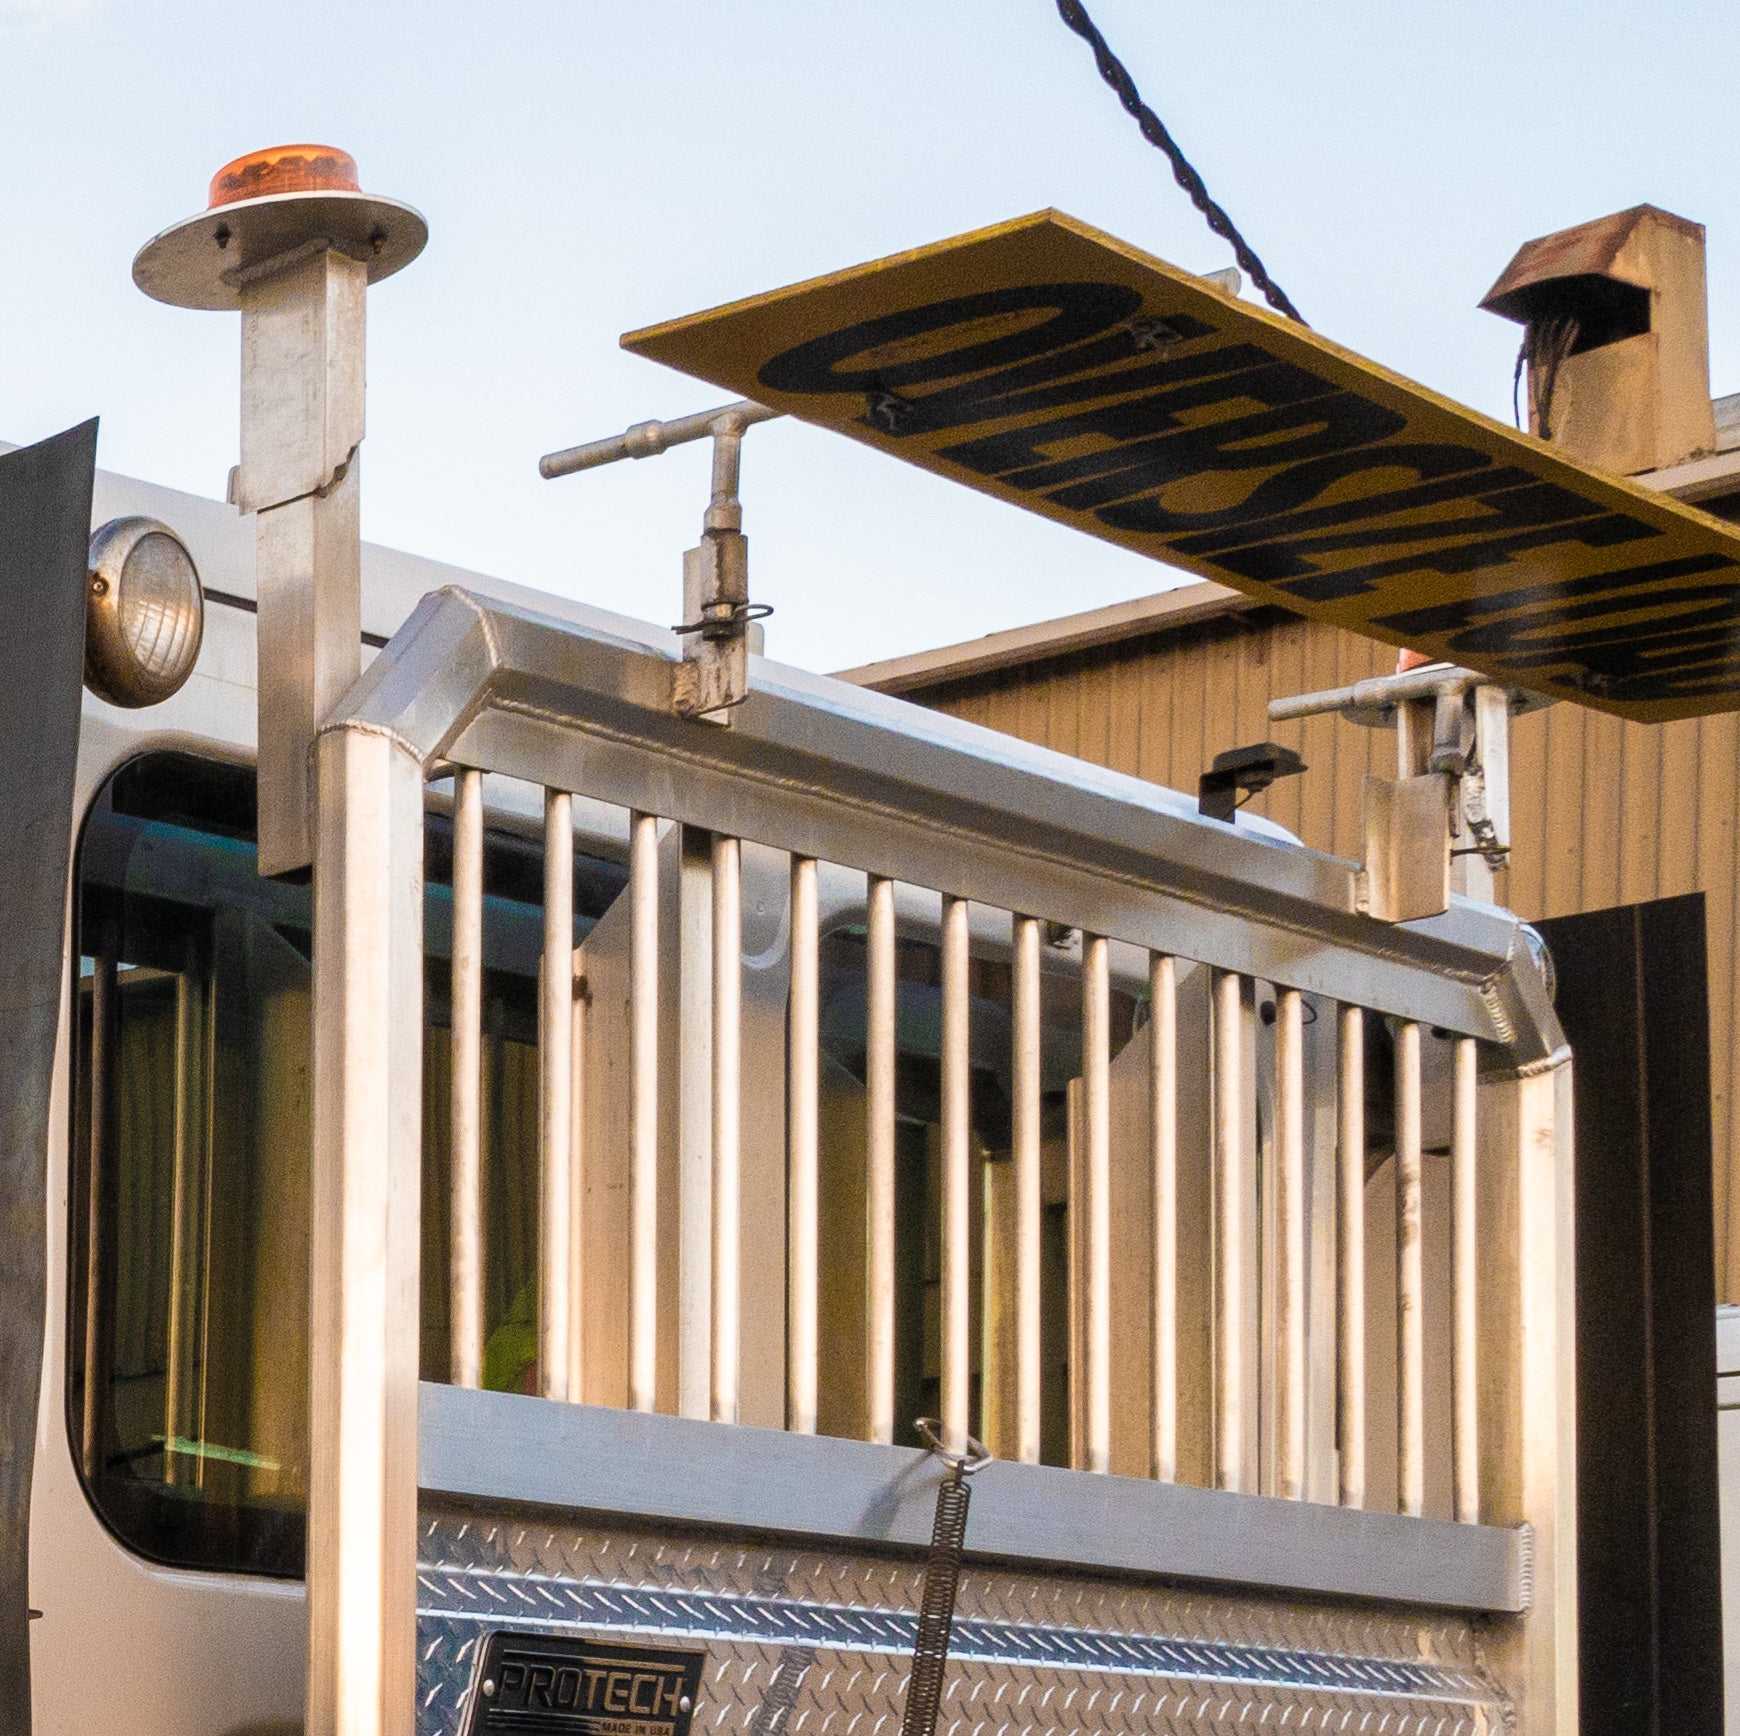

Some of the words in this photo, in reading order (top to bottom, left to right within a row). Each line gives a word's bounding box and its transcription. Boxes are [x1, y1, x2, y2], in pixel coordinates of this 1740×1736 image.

[756, 281, 1668, 602] OVERSIZE
[499, 1661, 685, 1717] PROTECH
[601, 1720, 631, 1735] MADE
[633, 1723, 647, 1736] IN
